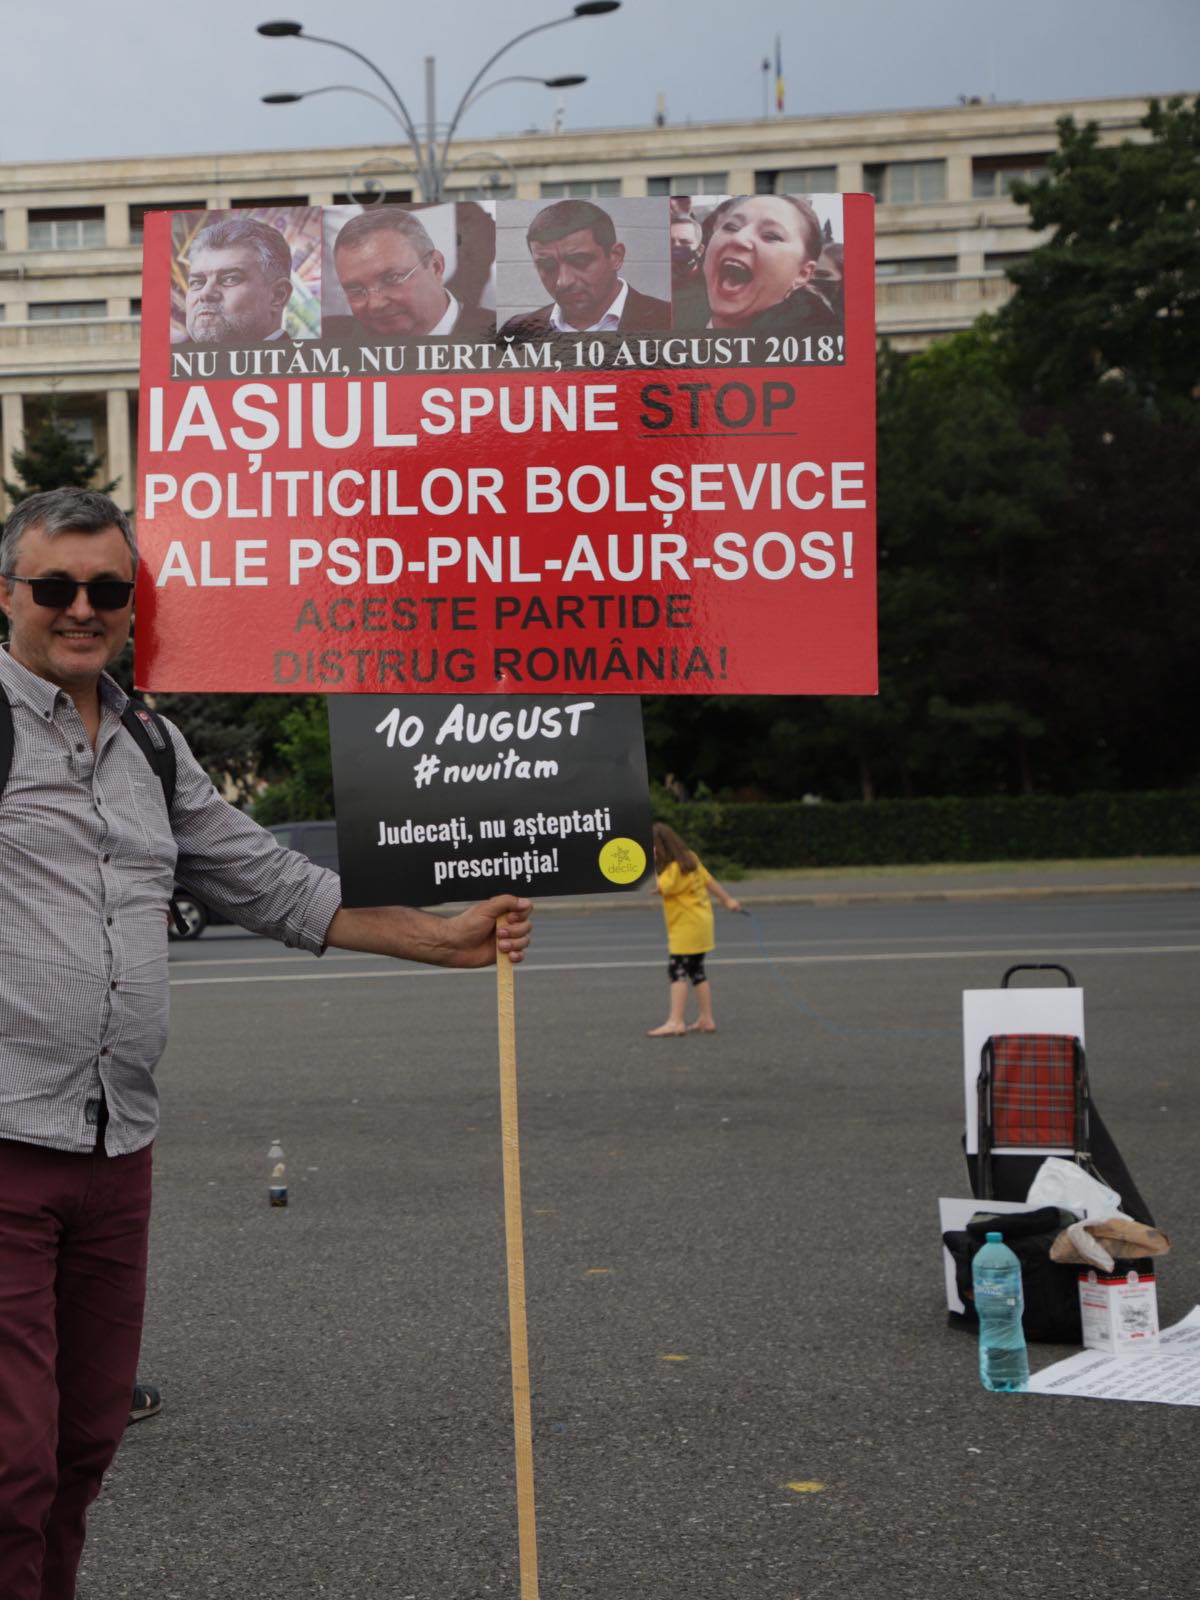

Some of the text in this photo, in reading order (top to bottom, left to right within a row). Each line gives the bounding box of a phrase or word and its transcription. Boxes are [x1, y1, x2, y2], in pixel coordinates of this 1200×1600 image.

[171, 336, 844, 378] NU UITĂM, NU IERTĂM, 10 AUGUST 2018!
[149, 381, 796, 474] IAȘIUL SPUNE STOP
[144, 461, 866, 528] POLITICILOR BOLȘEVICE
[155, 531, 854, 588] ALE PSD-PNL-AUR-SOS!
[295, 593, 693, 632] ACESTE PARTIDE
[274, 637, 728, 684] DISTRUG ROMÂNIA!
[374, 701, 596, 748] 10 AUGUST
[413, 748, 559, 789] #nuuitam
[377, 807, 611, 850] Judecați, nu așteptați
[434, 848, 559, 885] prescripția!
